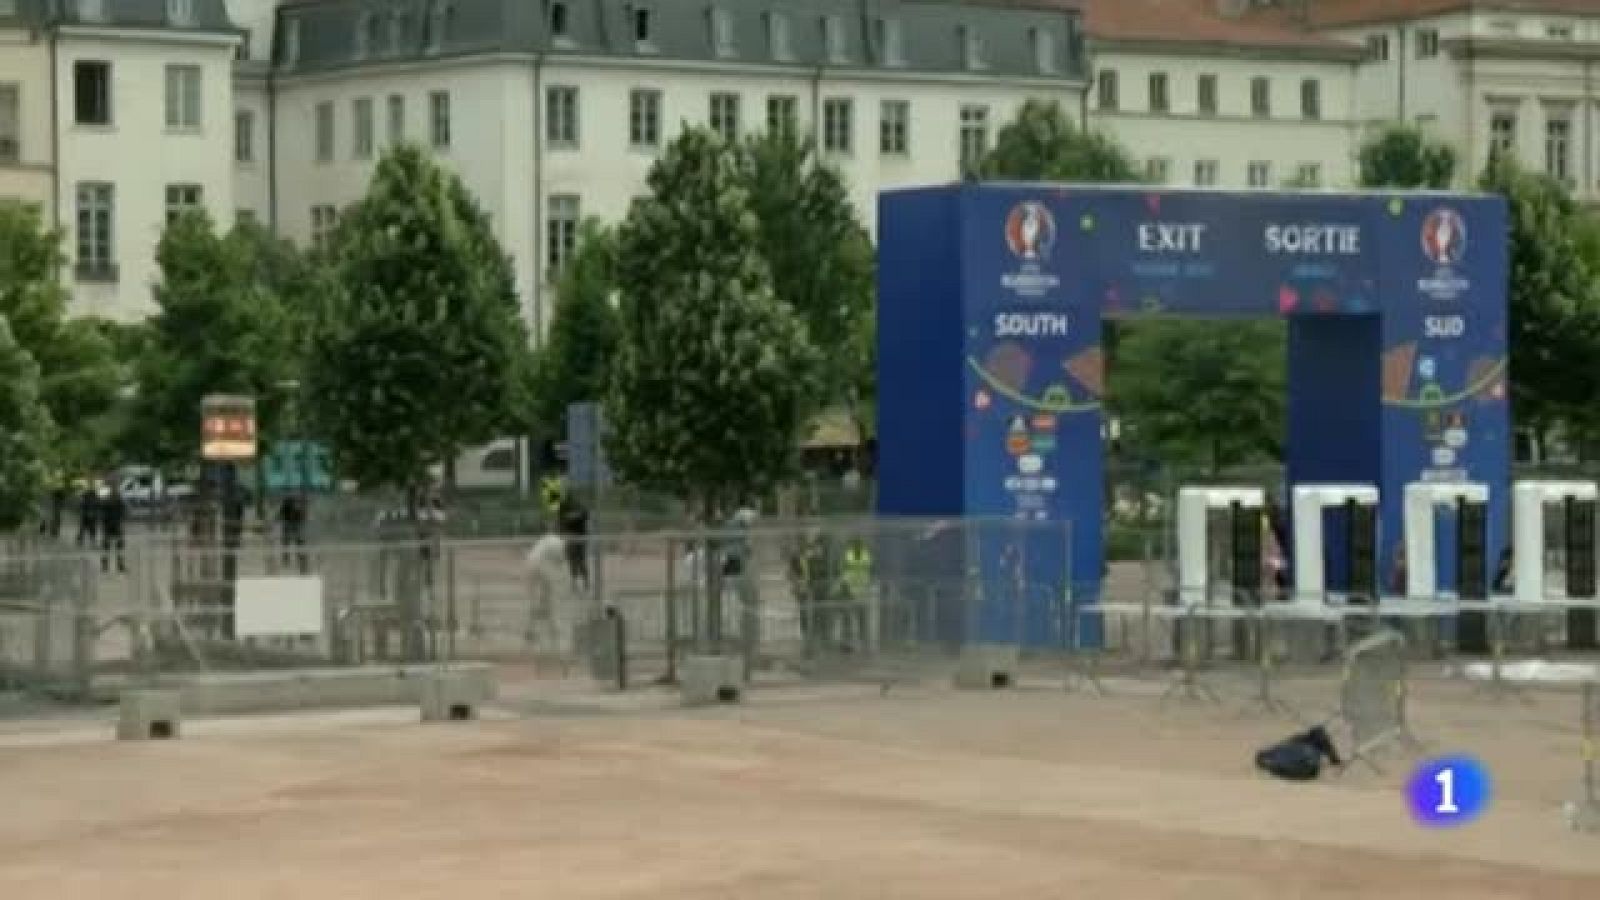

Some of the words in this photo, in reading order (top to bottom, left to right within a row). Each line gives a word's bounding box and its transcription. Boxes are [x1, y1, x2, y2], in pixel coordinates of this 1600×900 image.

[1138, 223, 1207, 252] EXIT
[1264, 224, 1361, 254] SORTIE
[994, 313, 1067, 336] SOUTH
[1424, 315, 1464, 337] SUD
